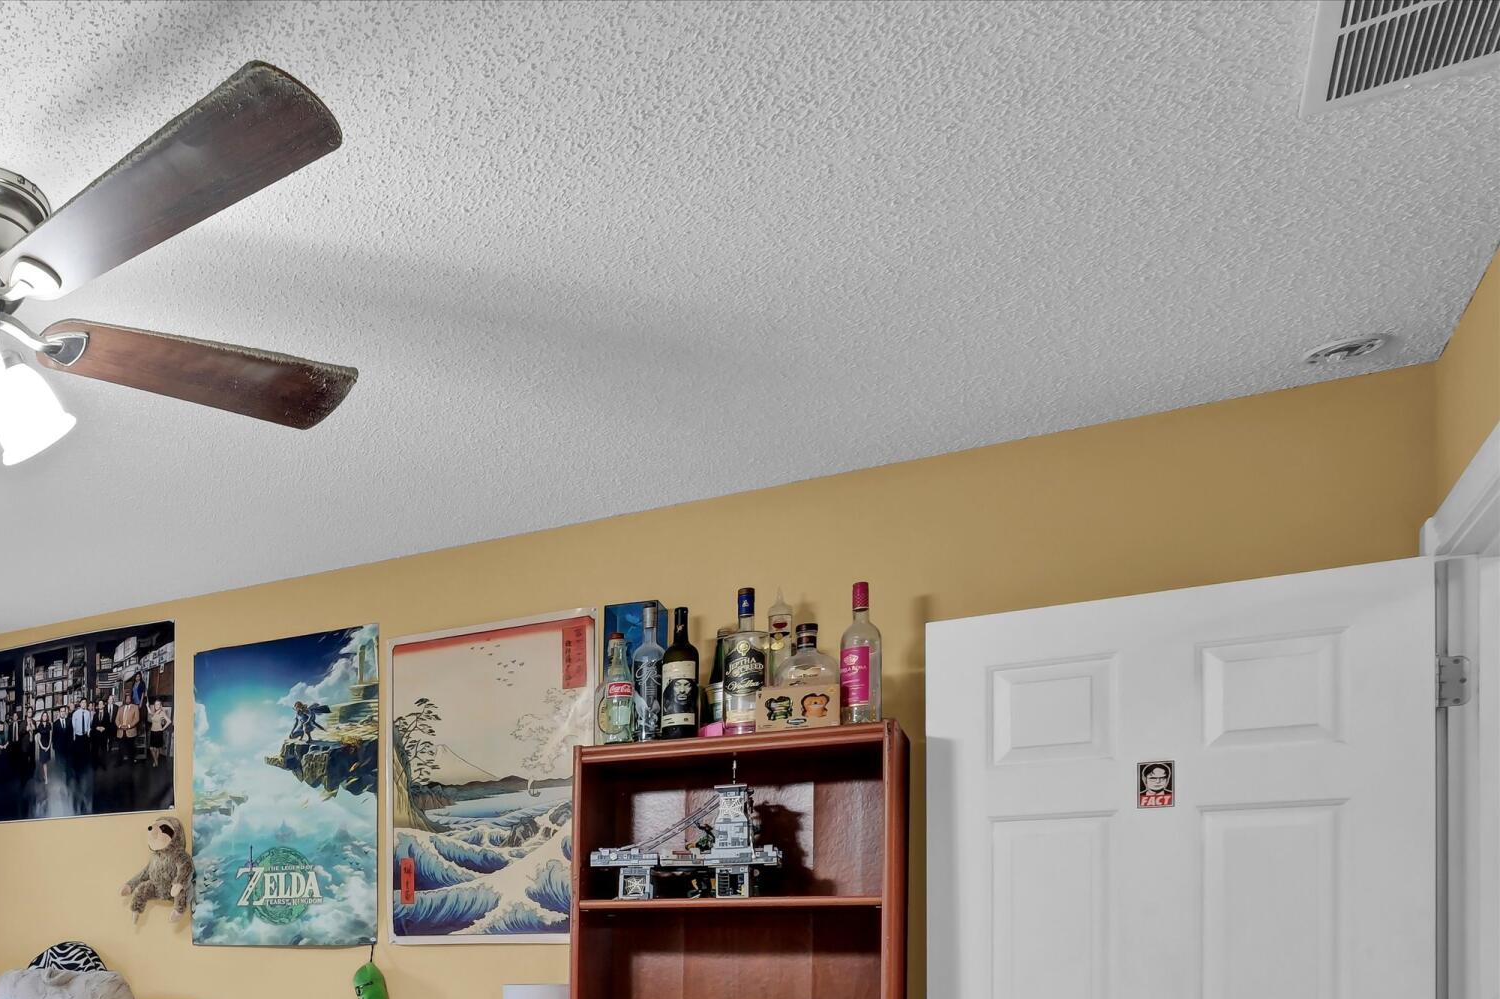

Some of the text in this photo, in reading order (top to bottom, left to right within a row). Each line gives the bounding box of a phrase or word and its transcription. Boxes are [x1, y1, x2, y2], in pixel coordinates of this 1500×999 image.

[726, 657, 757, 675] JEPTHA
[731, 663, 764, 678] CREED
[727, 678, 760, 691] Vodka
[1140, 795, 1172, 806] FACT
[236, 867, 323, 906] ZELDA
